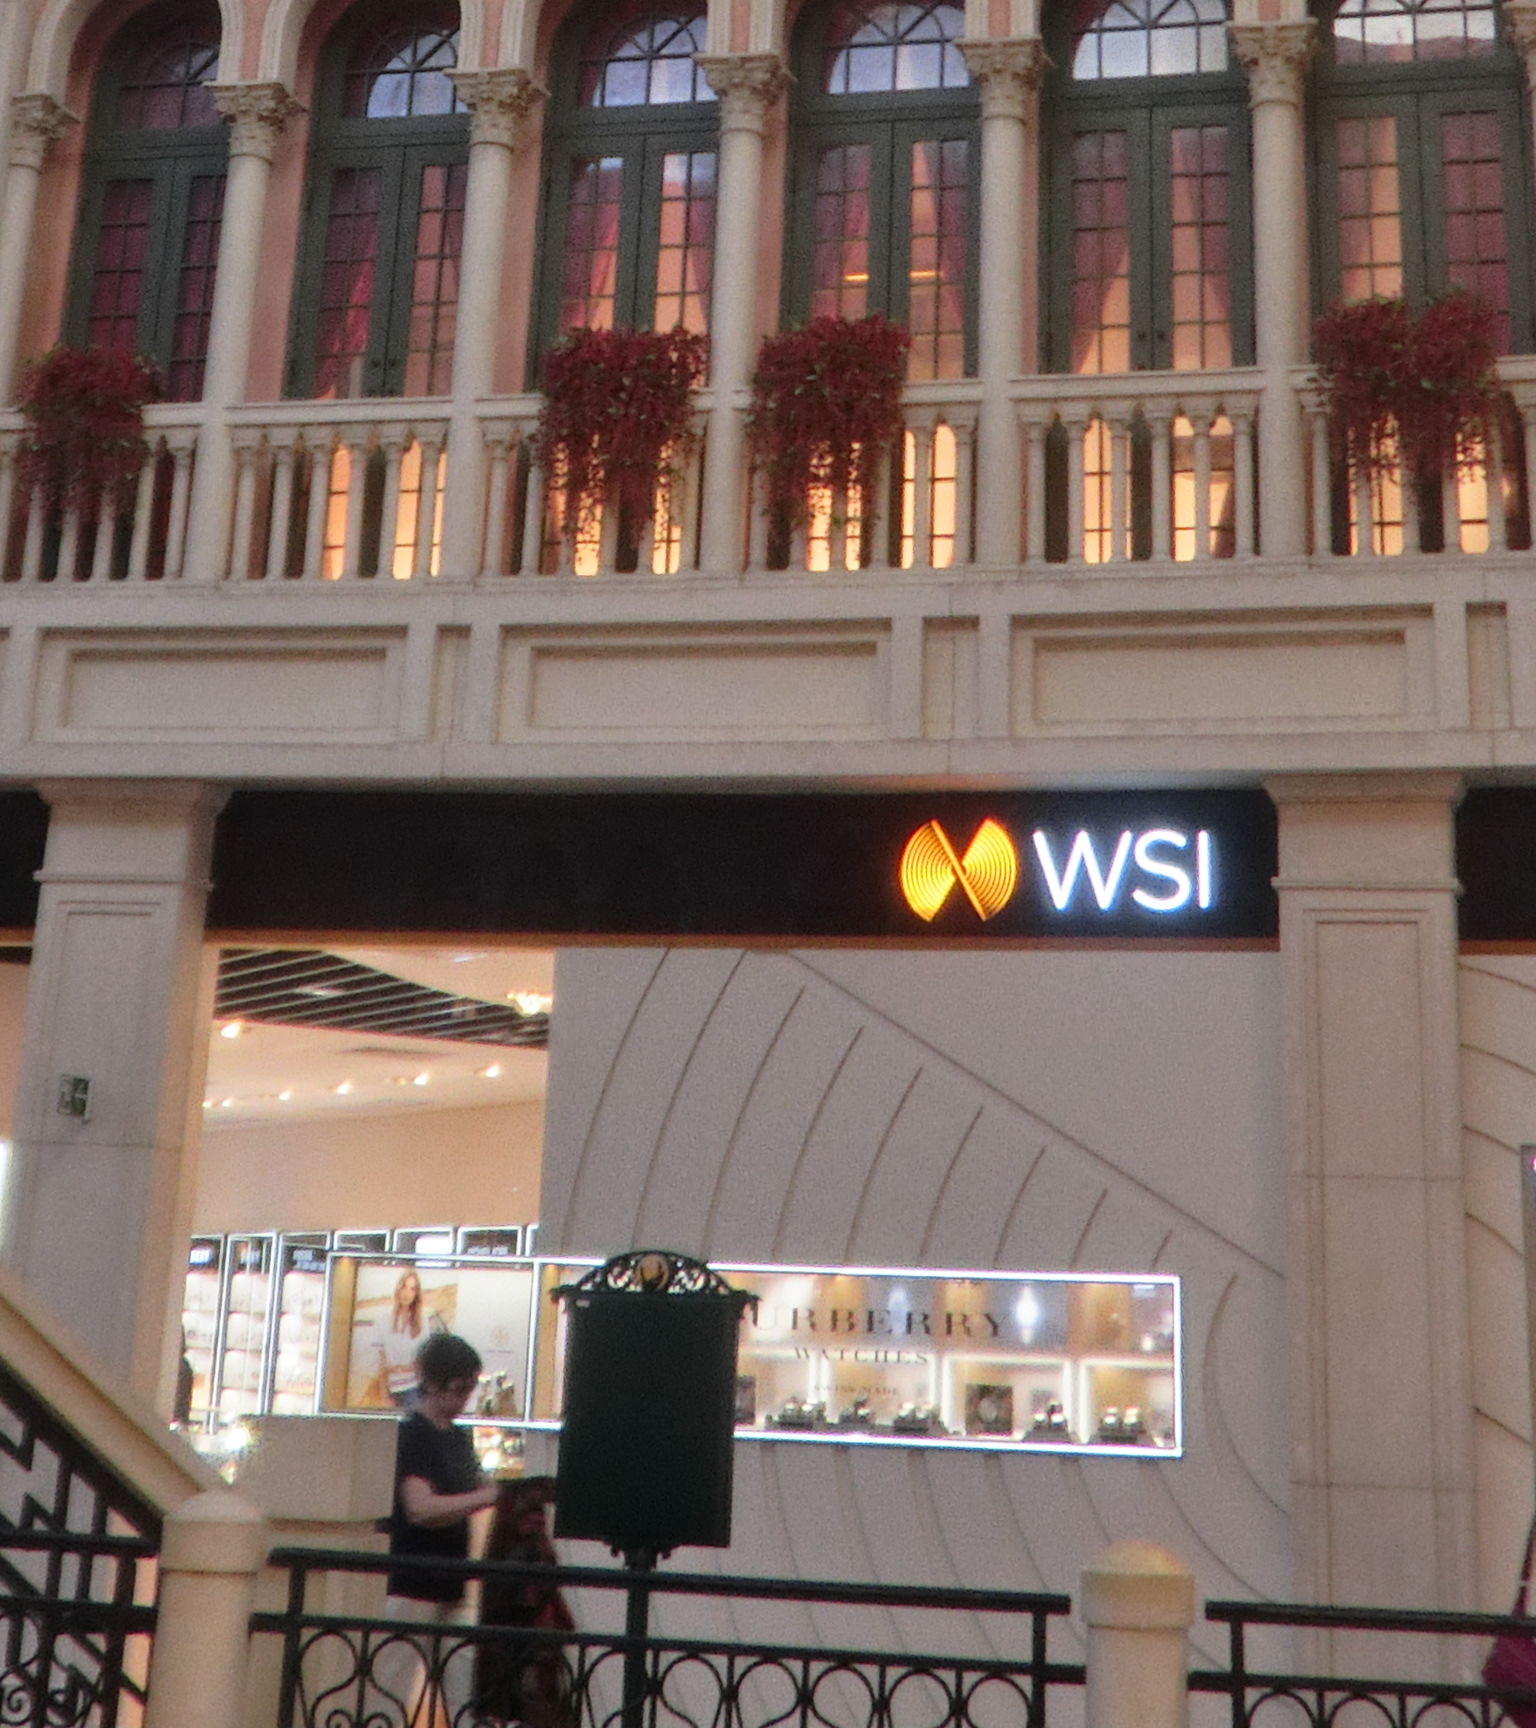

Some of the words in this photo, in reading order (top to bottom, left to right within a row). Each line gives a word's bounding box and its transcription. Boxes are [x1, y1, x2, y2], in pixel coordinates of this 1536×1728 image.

[1031, 829, 1210, 911] WSI
[747, 1302, 1006, 1338] URBERRY
[794, 1347, 929, 1365] WATCHES
